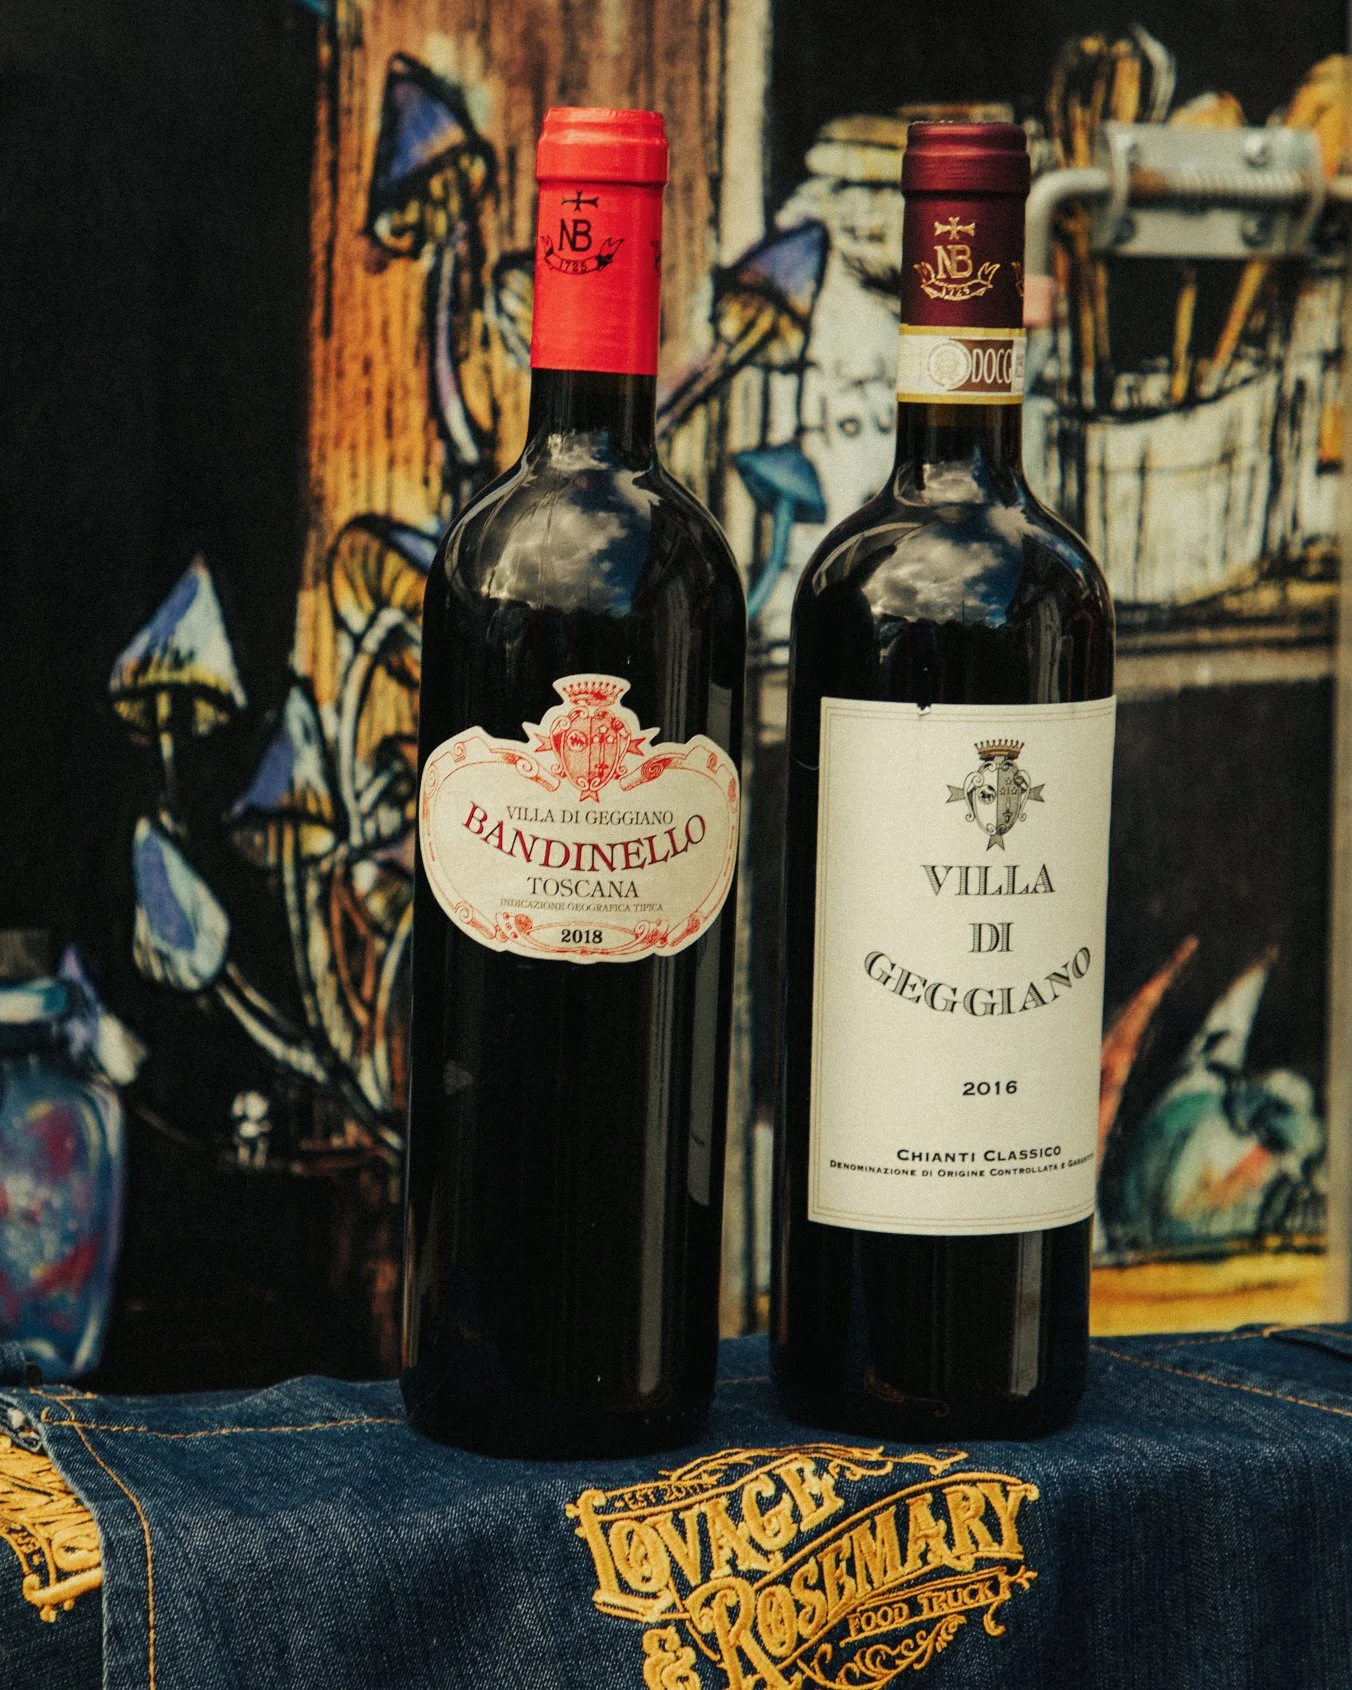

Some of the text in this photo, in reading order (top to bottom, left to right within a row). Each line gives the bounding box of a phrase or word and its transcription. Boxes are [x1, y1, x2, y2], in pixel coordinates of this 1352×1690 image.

[506, 805, 675, 826] VILLA DI GEGGIANO
[462, 801, 706, 872] BANDINELLO
[527, 876, 639, 898] TOSCANA
[921, 864, 1056, 896] VILLA
[500, 898, 664, 913] INDICAZIONE GEOGRAFICA TIPICA
[561, 928, 603, 945] 2018
[968, 922, 1015, 953] DI
[864, 946, 1092, 1017] GEGGIANO
[962, 1080, 1019, 1097] 2016
[565, 1456, 845, 1622] LOVAGE
[686, 1481, 1040, 1690] ROSEMARY
[848, 1579, 995, 1637] FOOD TRUCK
